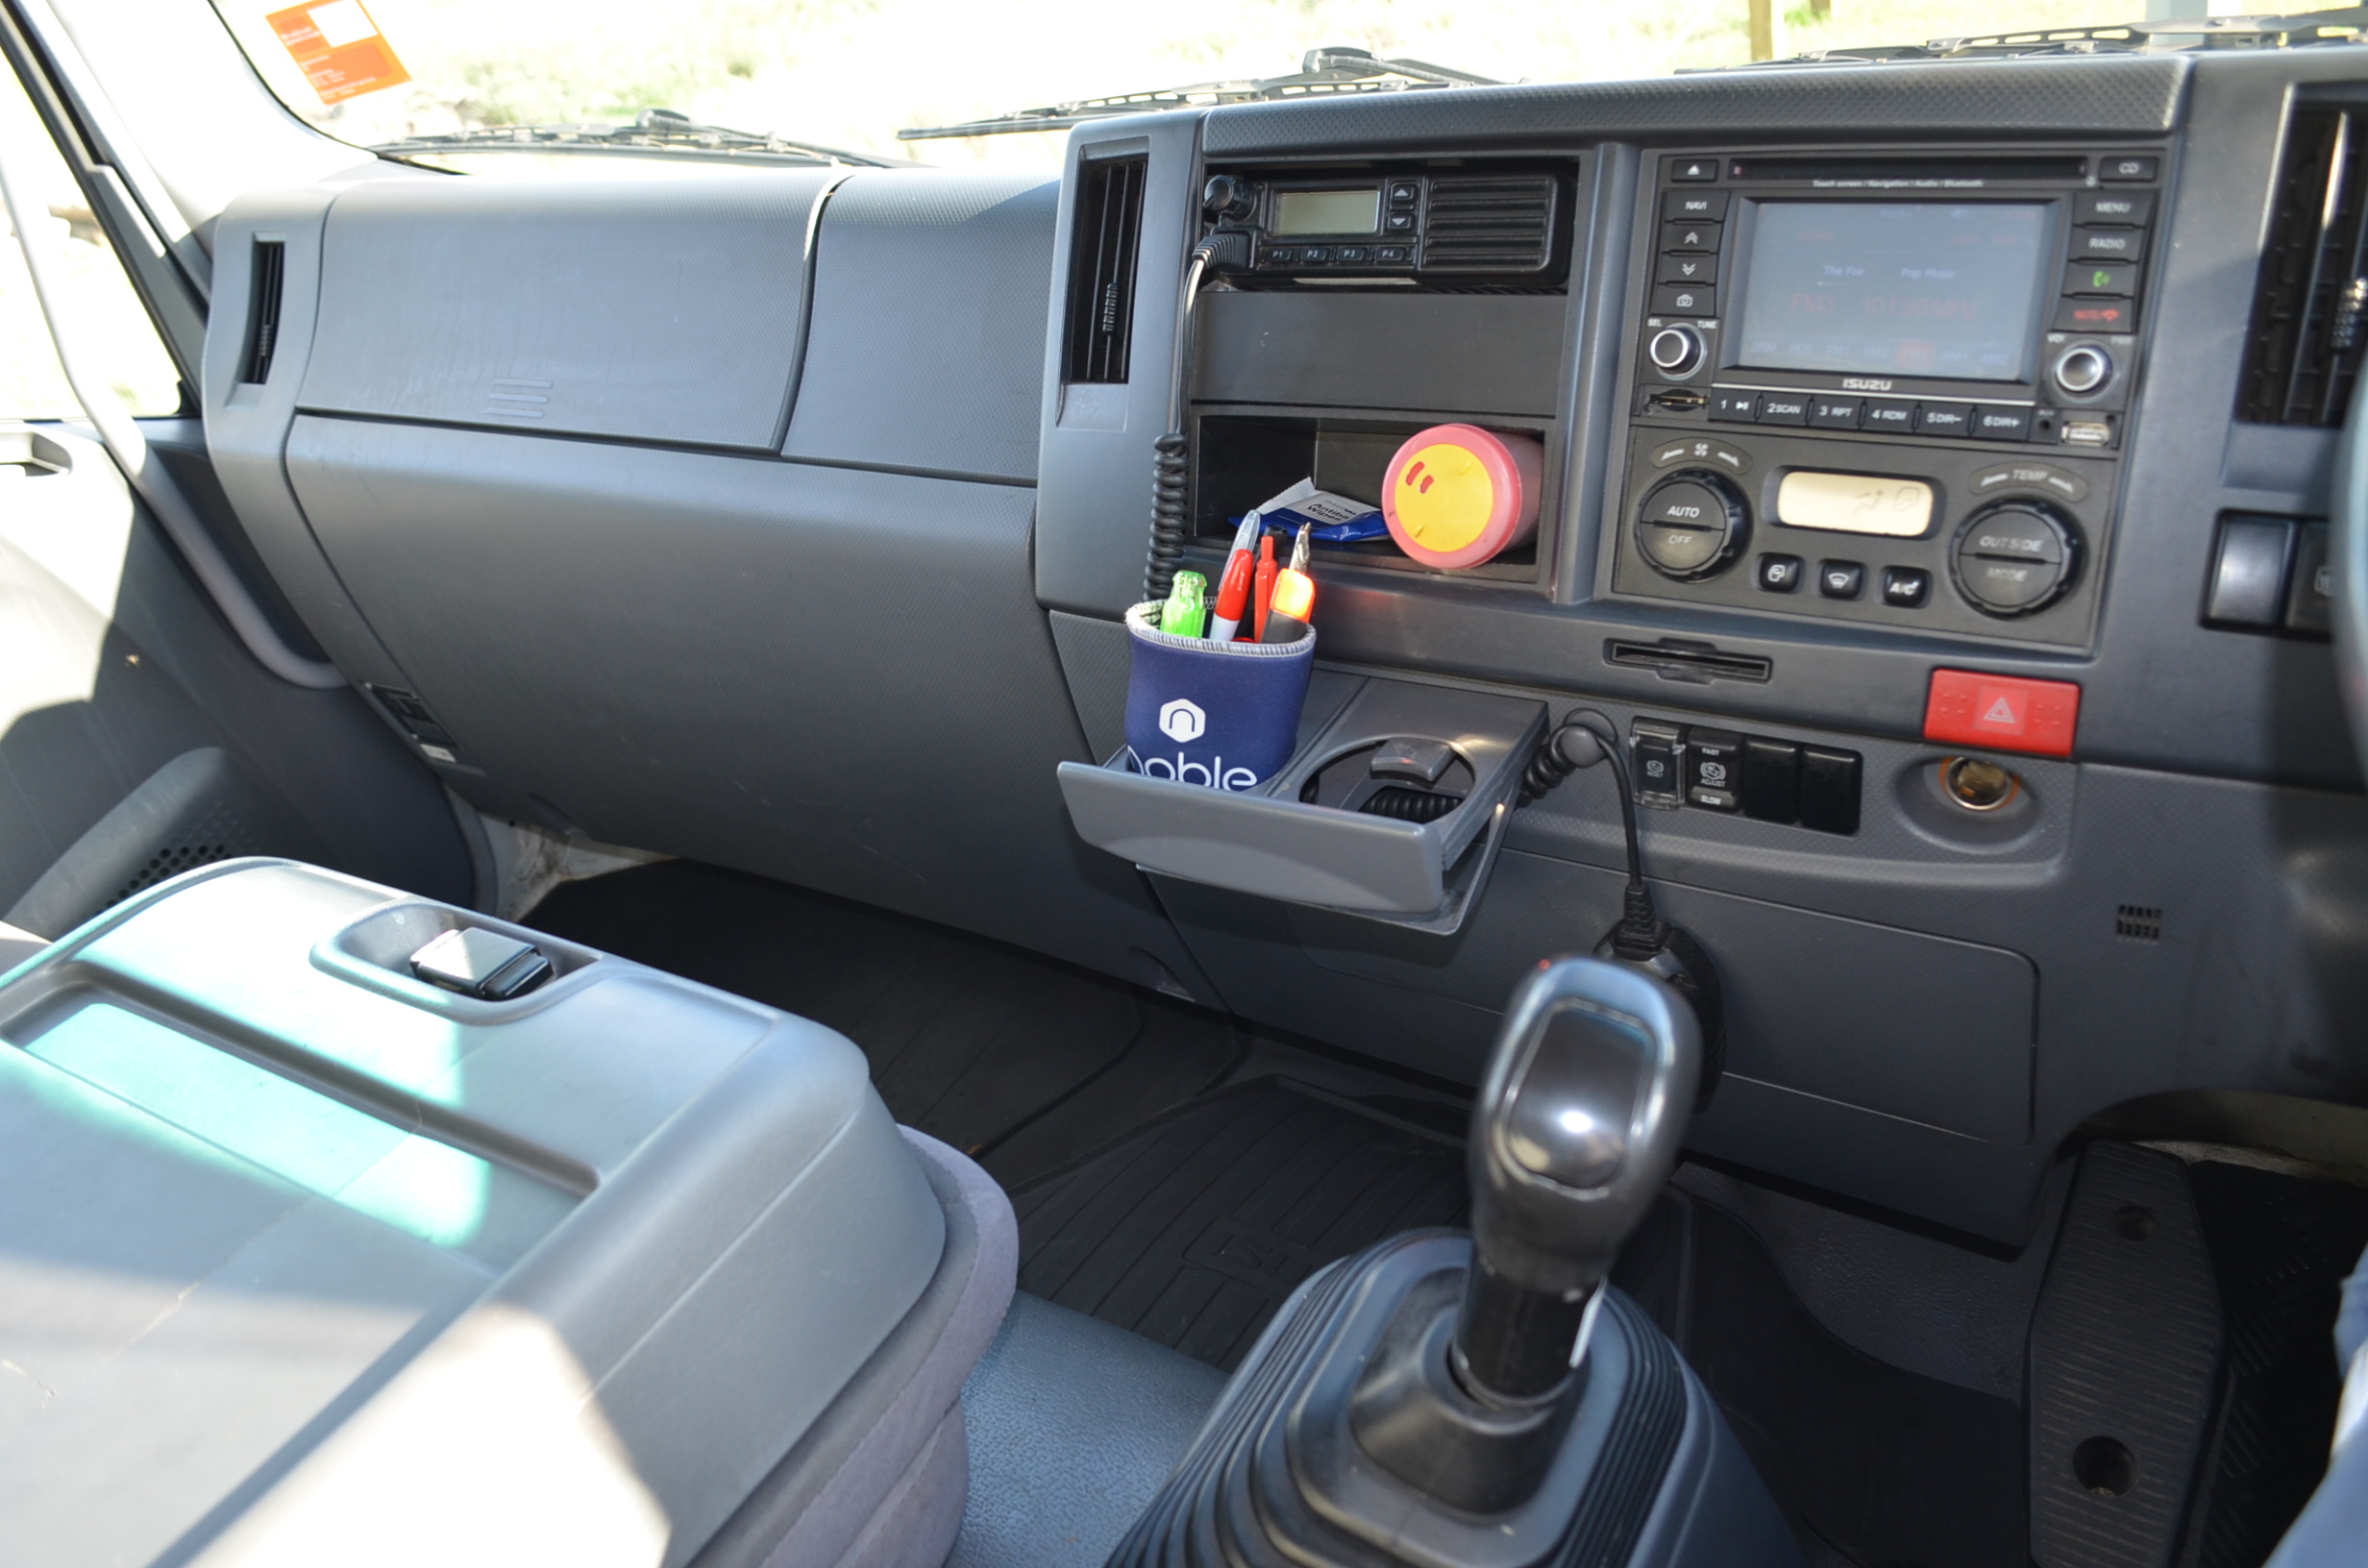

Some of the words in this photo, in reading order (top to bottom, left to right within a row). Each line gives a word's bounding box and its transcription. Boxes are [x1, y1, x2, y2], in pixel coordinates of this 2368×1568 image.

[2117, 161, 2140, 175] CD
[1685, 200, 1708, 210] NAVI
[2094, 201, 2132, 214] MENU
[2087, 237, 2127, 251] RADIO
[1271, 250, 1284, 258] P1
[1306, 250, 1320, 258] P2
[1343, 249, 1356, 258] P3
[1381, 249, 1394, 257] P4
[1789, 292, 1837, 315] FM3
[1646, 317, 1664, 328] SEL
[1695, 319, 1718, 330] TUNE
[1841, 378, 1893, 392] ISUZU
[2011, 468, 2049, 481] TEMP
[1307, 504, 1343, 522] Wipes
[1665, 504, 1701, 519] AUTO
[1667, 534, 1693, 546] OFF
[1978, 534, 2044, 552] OUTSDE
[1888, 580, 1918, 597] A/C
[1701, 747, 1720, 756] FAST
[1700, 777, 1726, 788] ADJUST
[1700, 795, 1722, 805] SLOW
